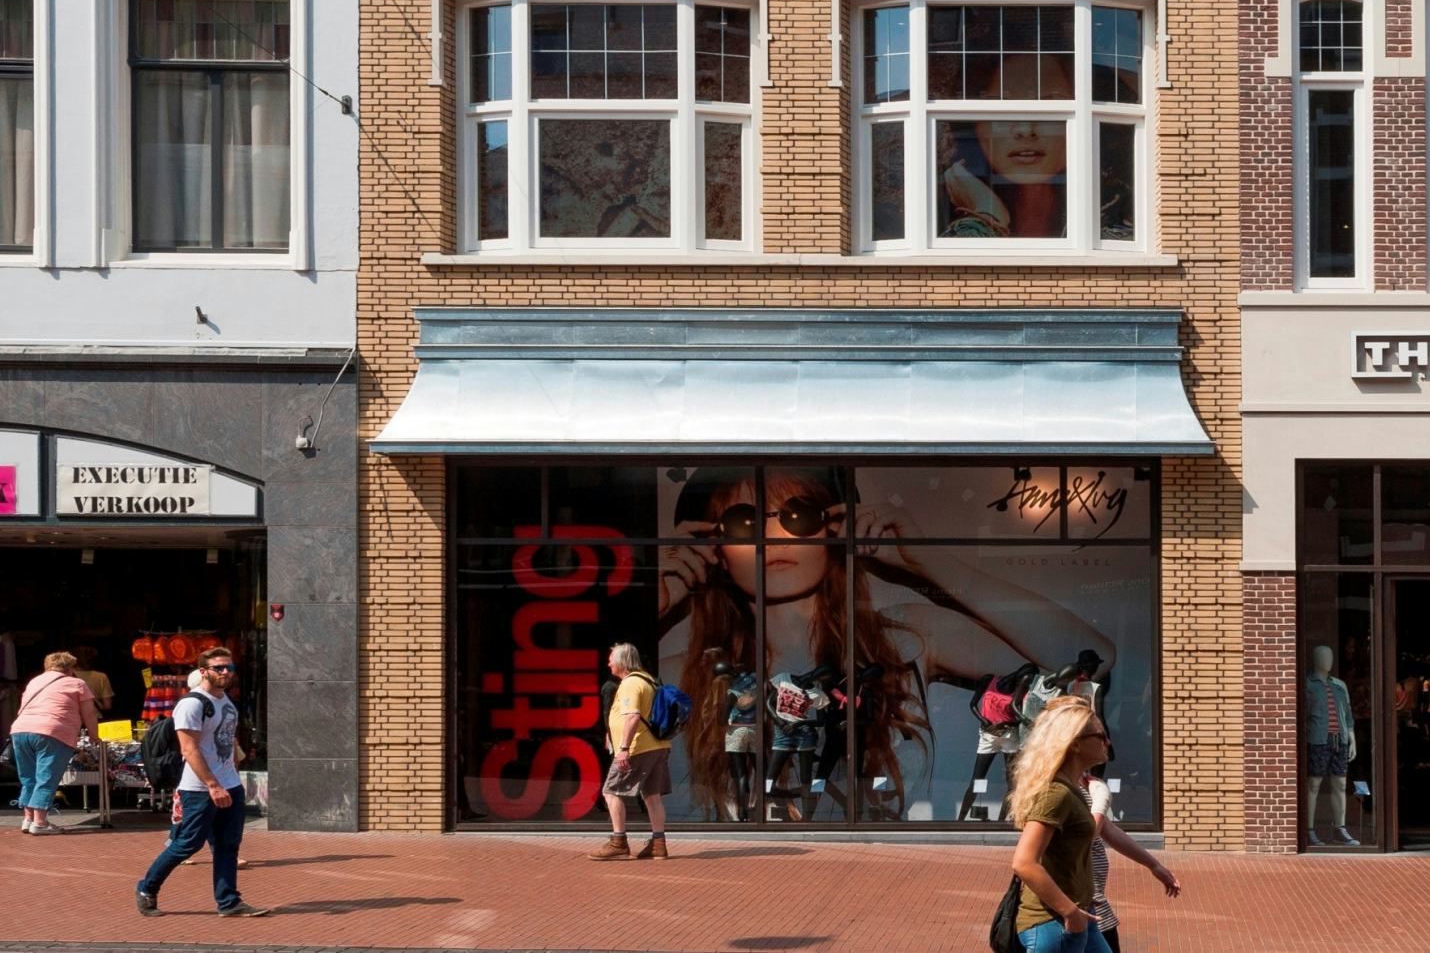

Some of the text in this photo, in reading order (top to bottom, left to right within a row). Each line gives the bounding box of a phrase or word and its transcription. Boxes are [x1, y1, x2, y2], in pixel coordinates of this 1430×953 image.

[72, 467, 197, 484] EXECUTIE
[74, 496, 195, 513] VERKOOP
[480, 524, 635, 822] Sting
